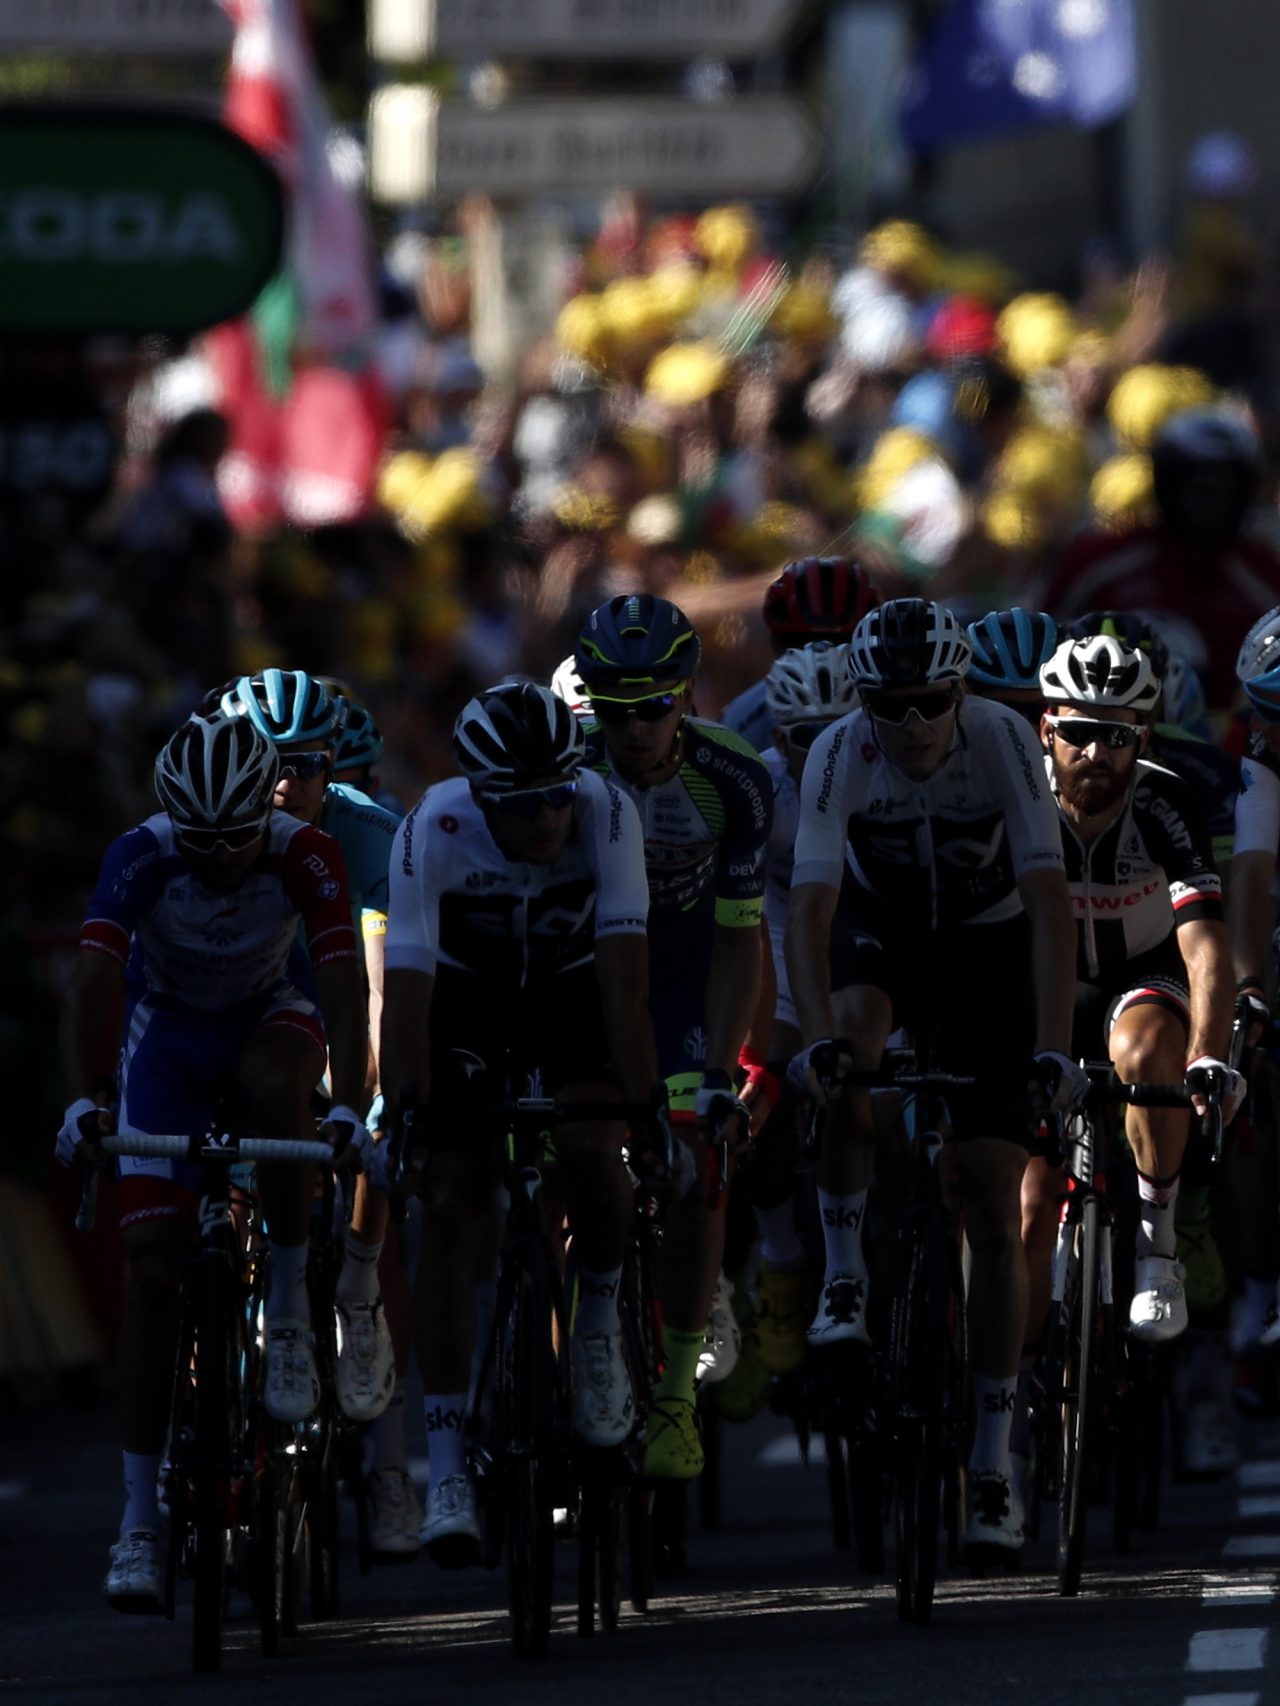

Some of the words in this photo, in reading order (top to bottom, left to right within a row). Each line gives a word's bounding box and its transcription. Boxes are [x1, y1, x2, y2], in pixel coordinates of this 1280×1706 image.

[712, 755, 768, 831] startpeople
[816, 723, 848, 815] #PassOnPlastic
[1150, 797, 1192, 850] GIANT
[823, 1204, 864, 1231] sky
[426, 1405, 465, 1433] sky
